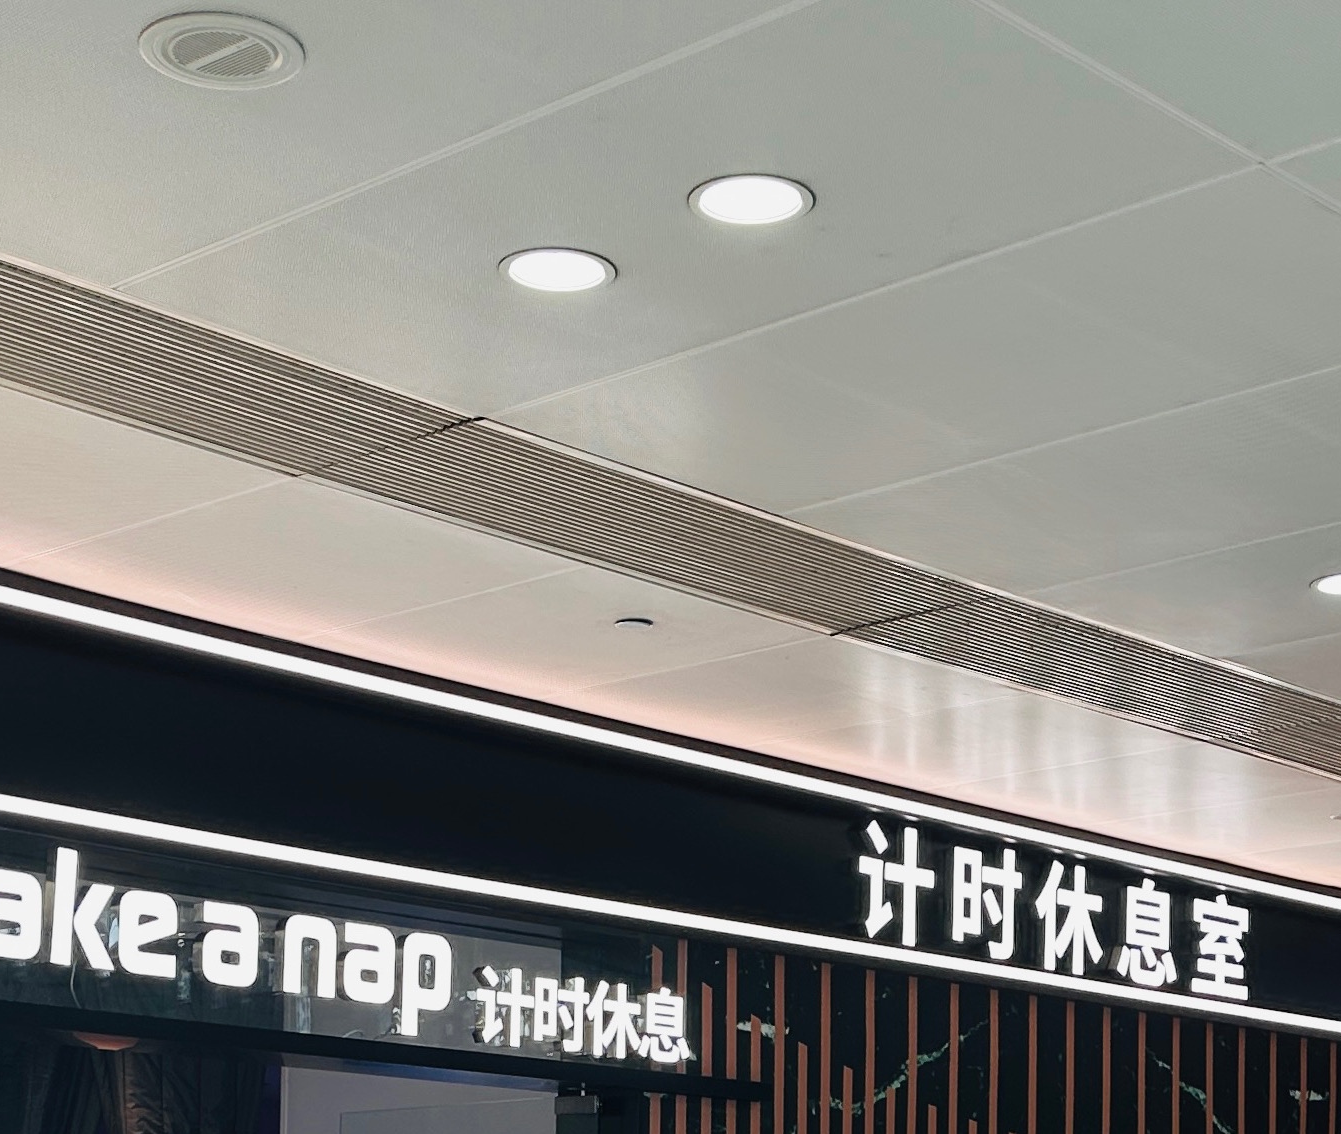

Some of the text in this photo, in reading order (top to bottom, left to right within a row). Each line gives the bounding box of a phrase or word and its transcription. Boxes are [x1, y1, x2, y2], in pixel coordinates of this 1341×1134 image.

[200, 900, 260, 988] a
[281, 913, 454, 1038] nap
[858, 819, 1251, 1001] 计时休息室
[474, 963, 691, 1064] 计时休息
